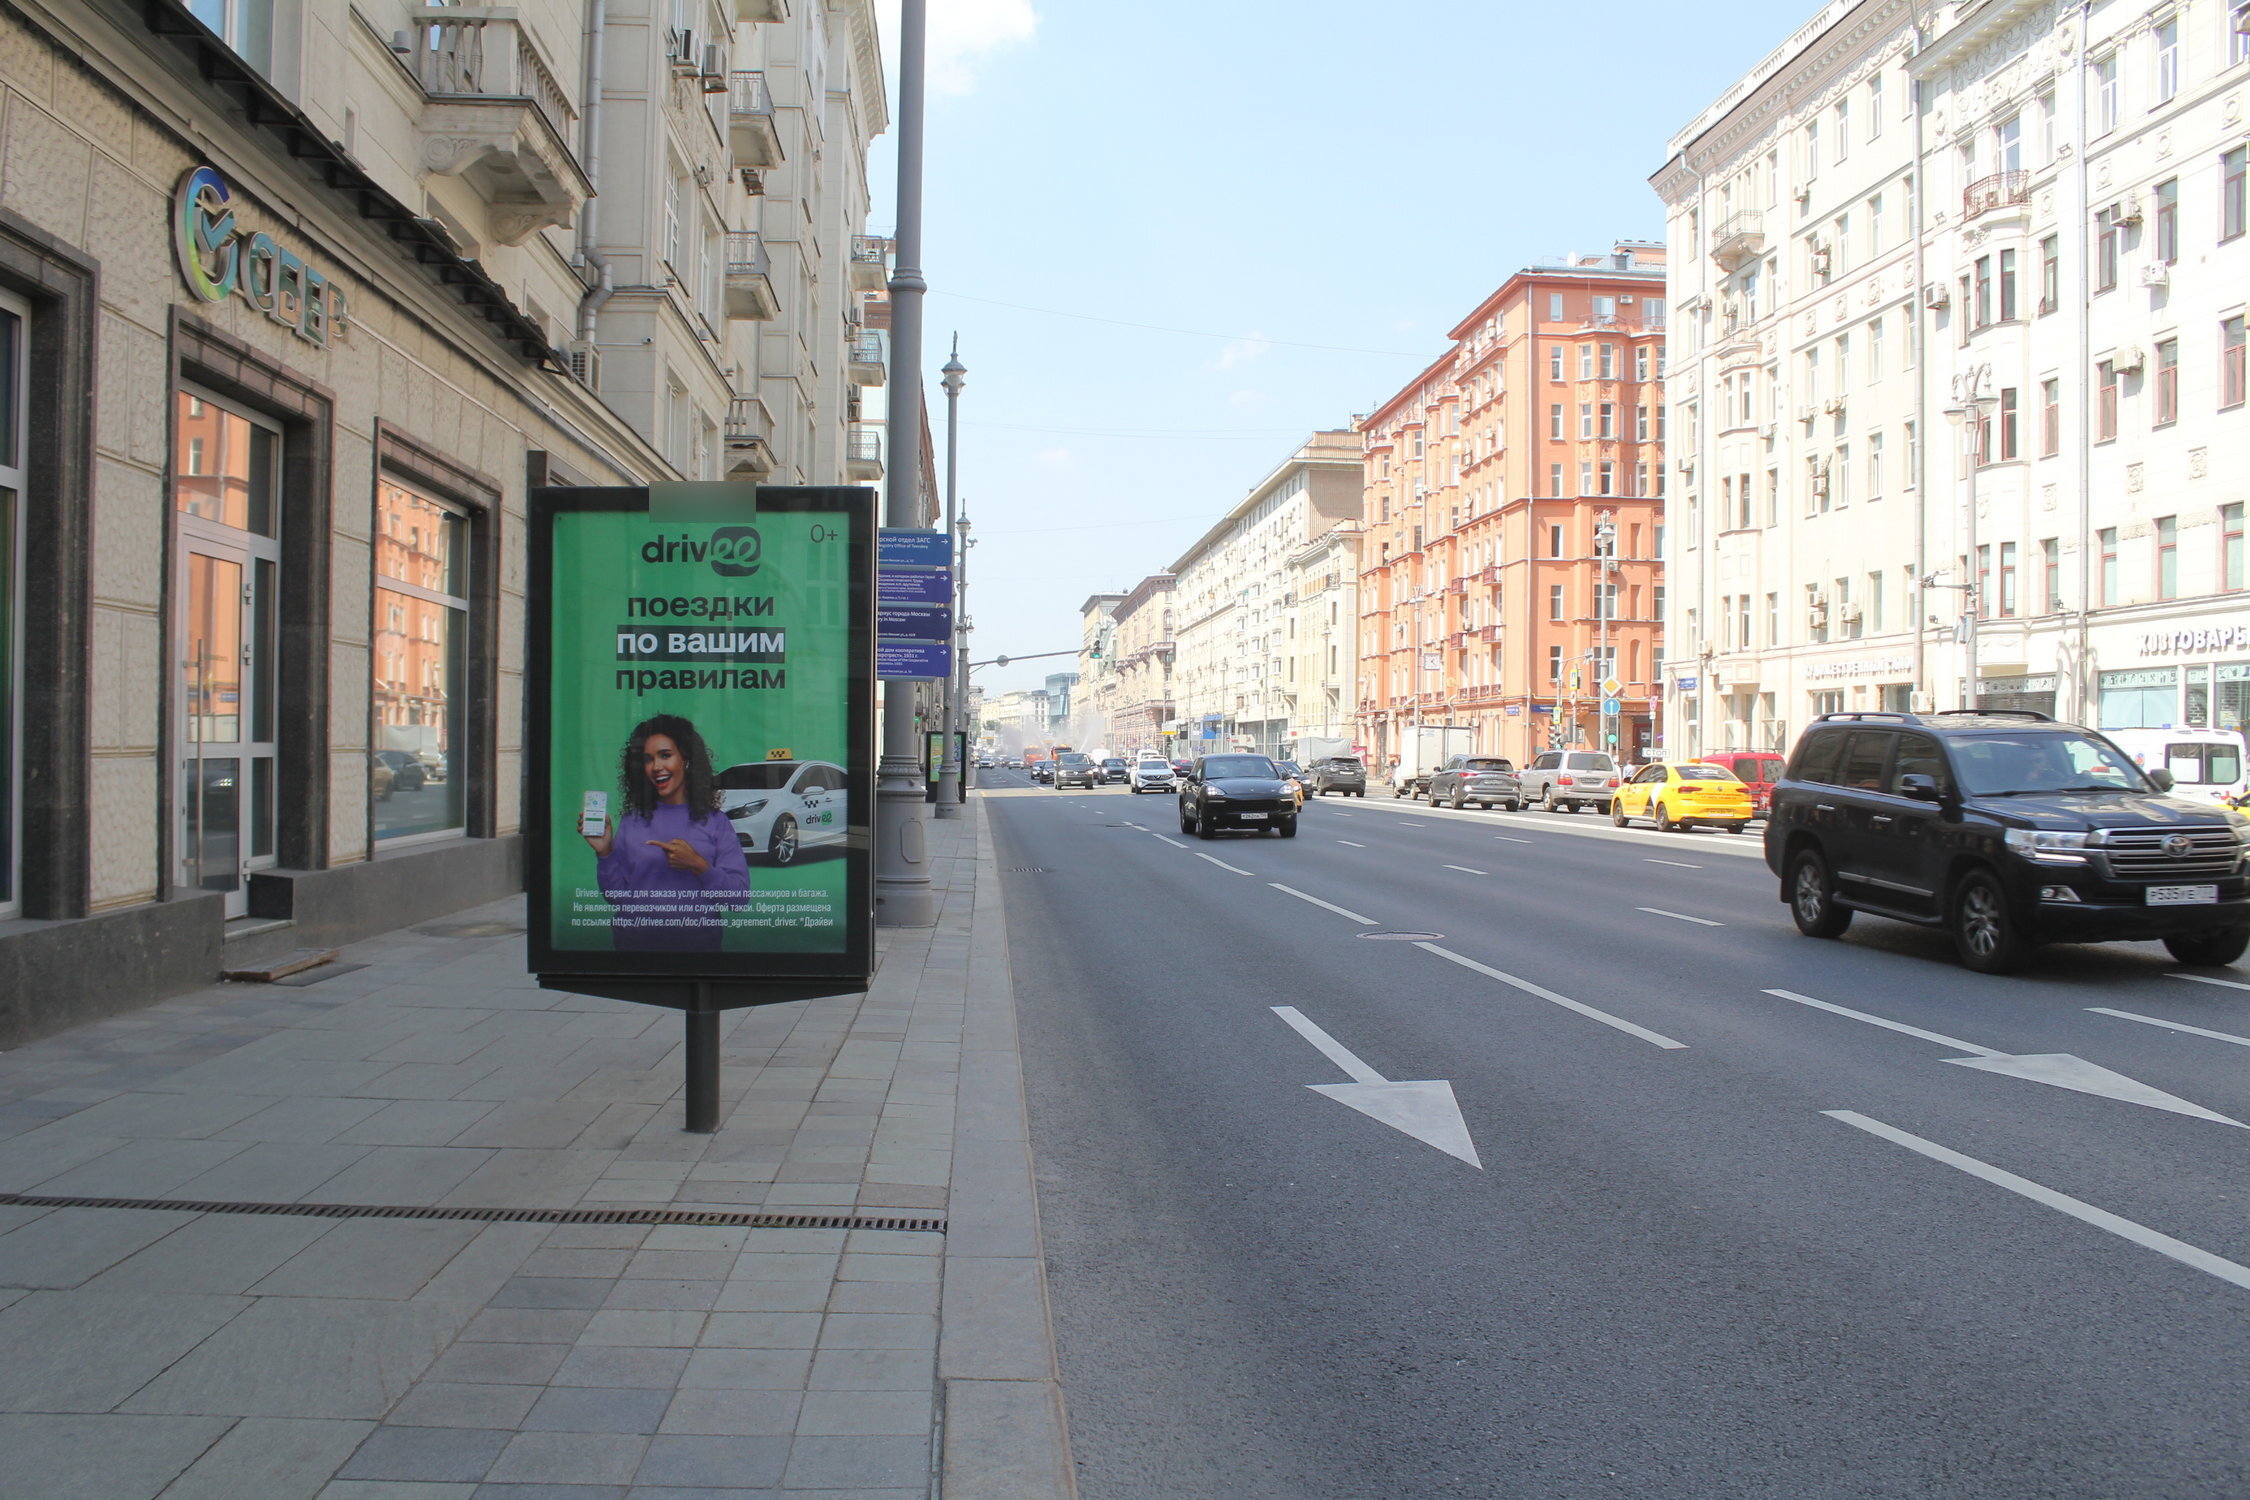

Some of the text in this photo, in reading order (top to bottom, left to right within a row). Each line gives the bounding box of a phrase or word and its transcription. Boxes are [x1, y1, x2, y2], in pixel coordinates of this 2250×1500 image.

[240, 231, 349, 351] СБЕР
[810, 524, 838, 543] 0+
[641, 529, 761, 571] drivee
[628, 596, 774, 621] поездки
[617, 632, 785, 653] по вашим
[616, 669, 786, 696] правилам
[576, 888, 598, 898] Drivee
[605, 889, 632, 899] сервис
[633, 889, 648, 899] для
[650, 889, 676, 898] заказа
[678, 889, 699, 899] услуг
[700, 889, 741, 899] перевозки
[743, 889, 790, 899] пассажиров
[791, 889, 797, 898] и
[798, 888, 829, 898] багажа.
[573, 903, 831, 913] Не является перевозчиком или службой такси. Оферта размещена
[582, 918, 611, 926] ссылке
